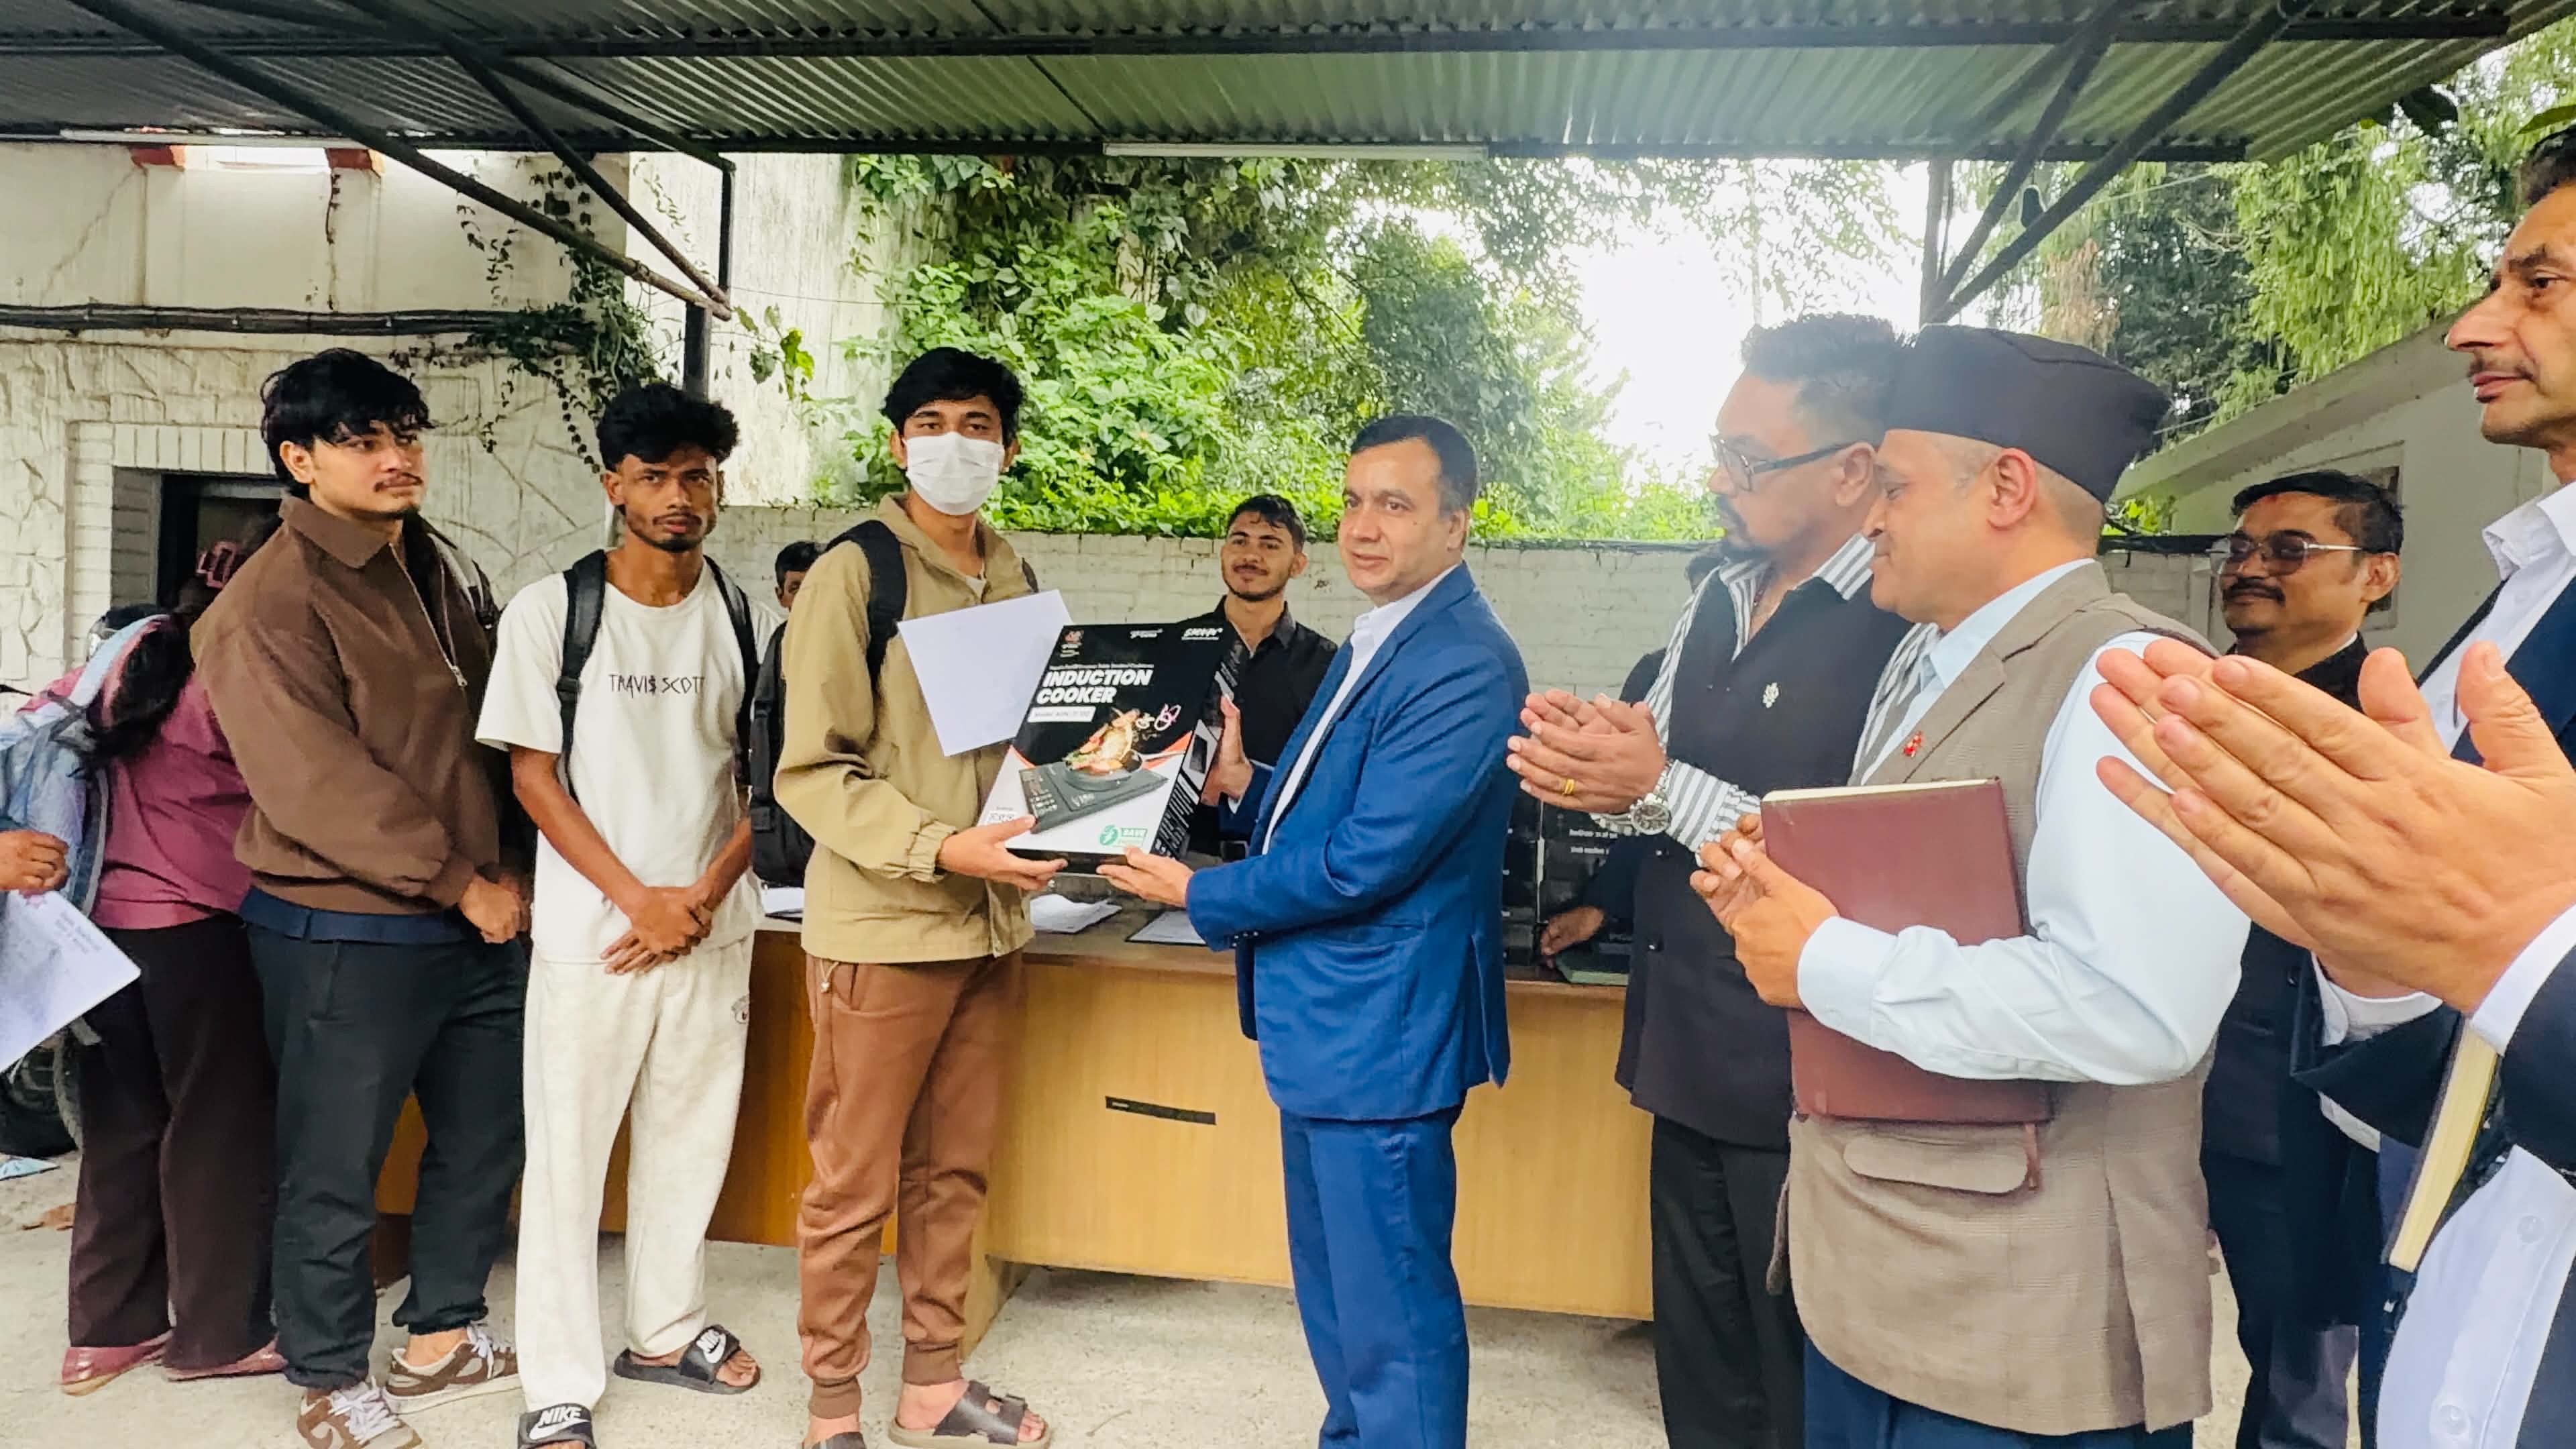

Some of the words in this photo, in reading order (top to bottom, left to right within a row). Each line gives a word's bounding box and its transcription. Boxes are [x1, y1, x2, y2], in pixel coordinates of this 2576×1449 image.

[1042, 669, 1153, 687] INDUCTION
[1036, 686, 1117, 704] COOKER
[539, 1406, 582, 1426] NIKE
